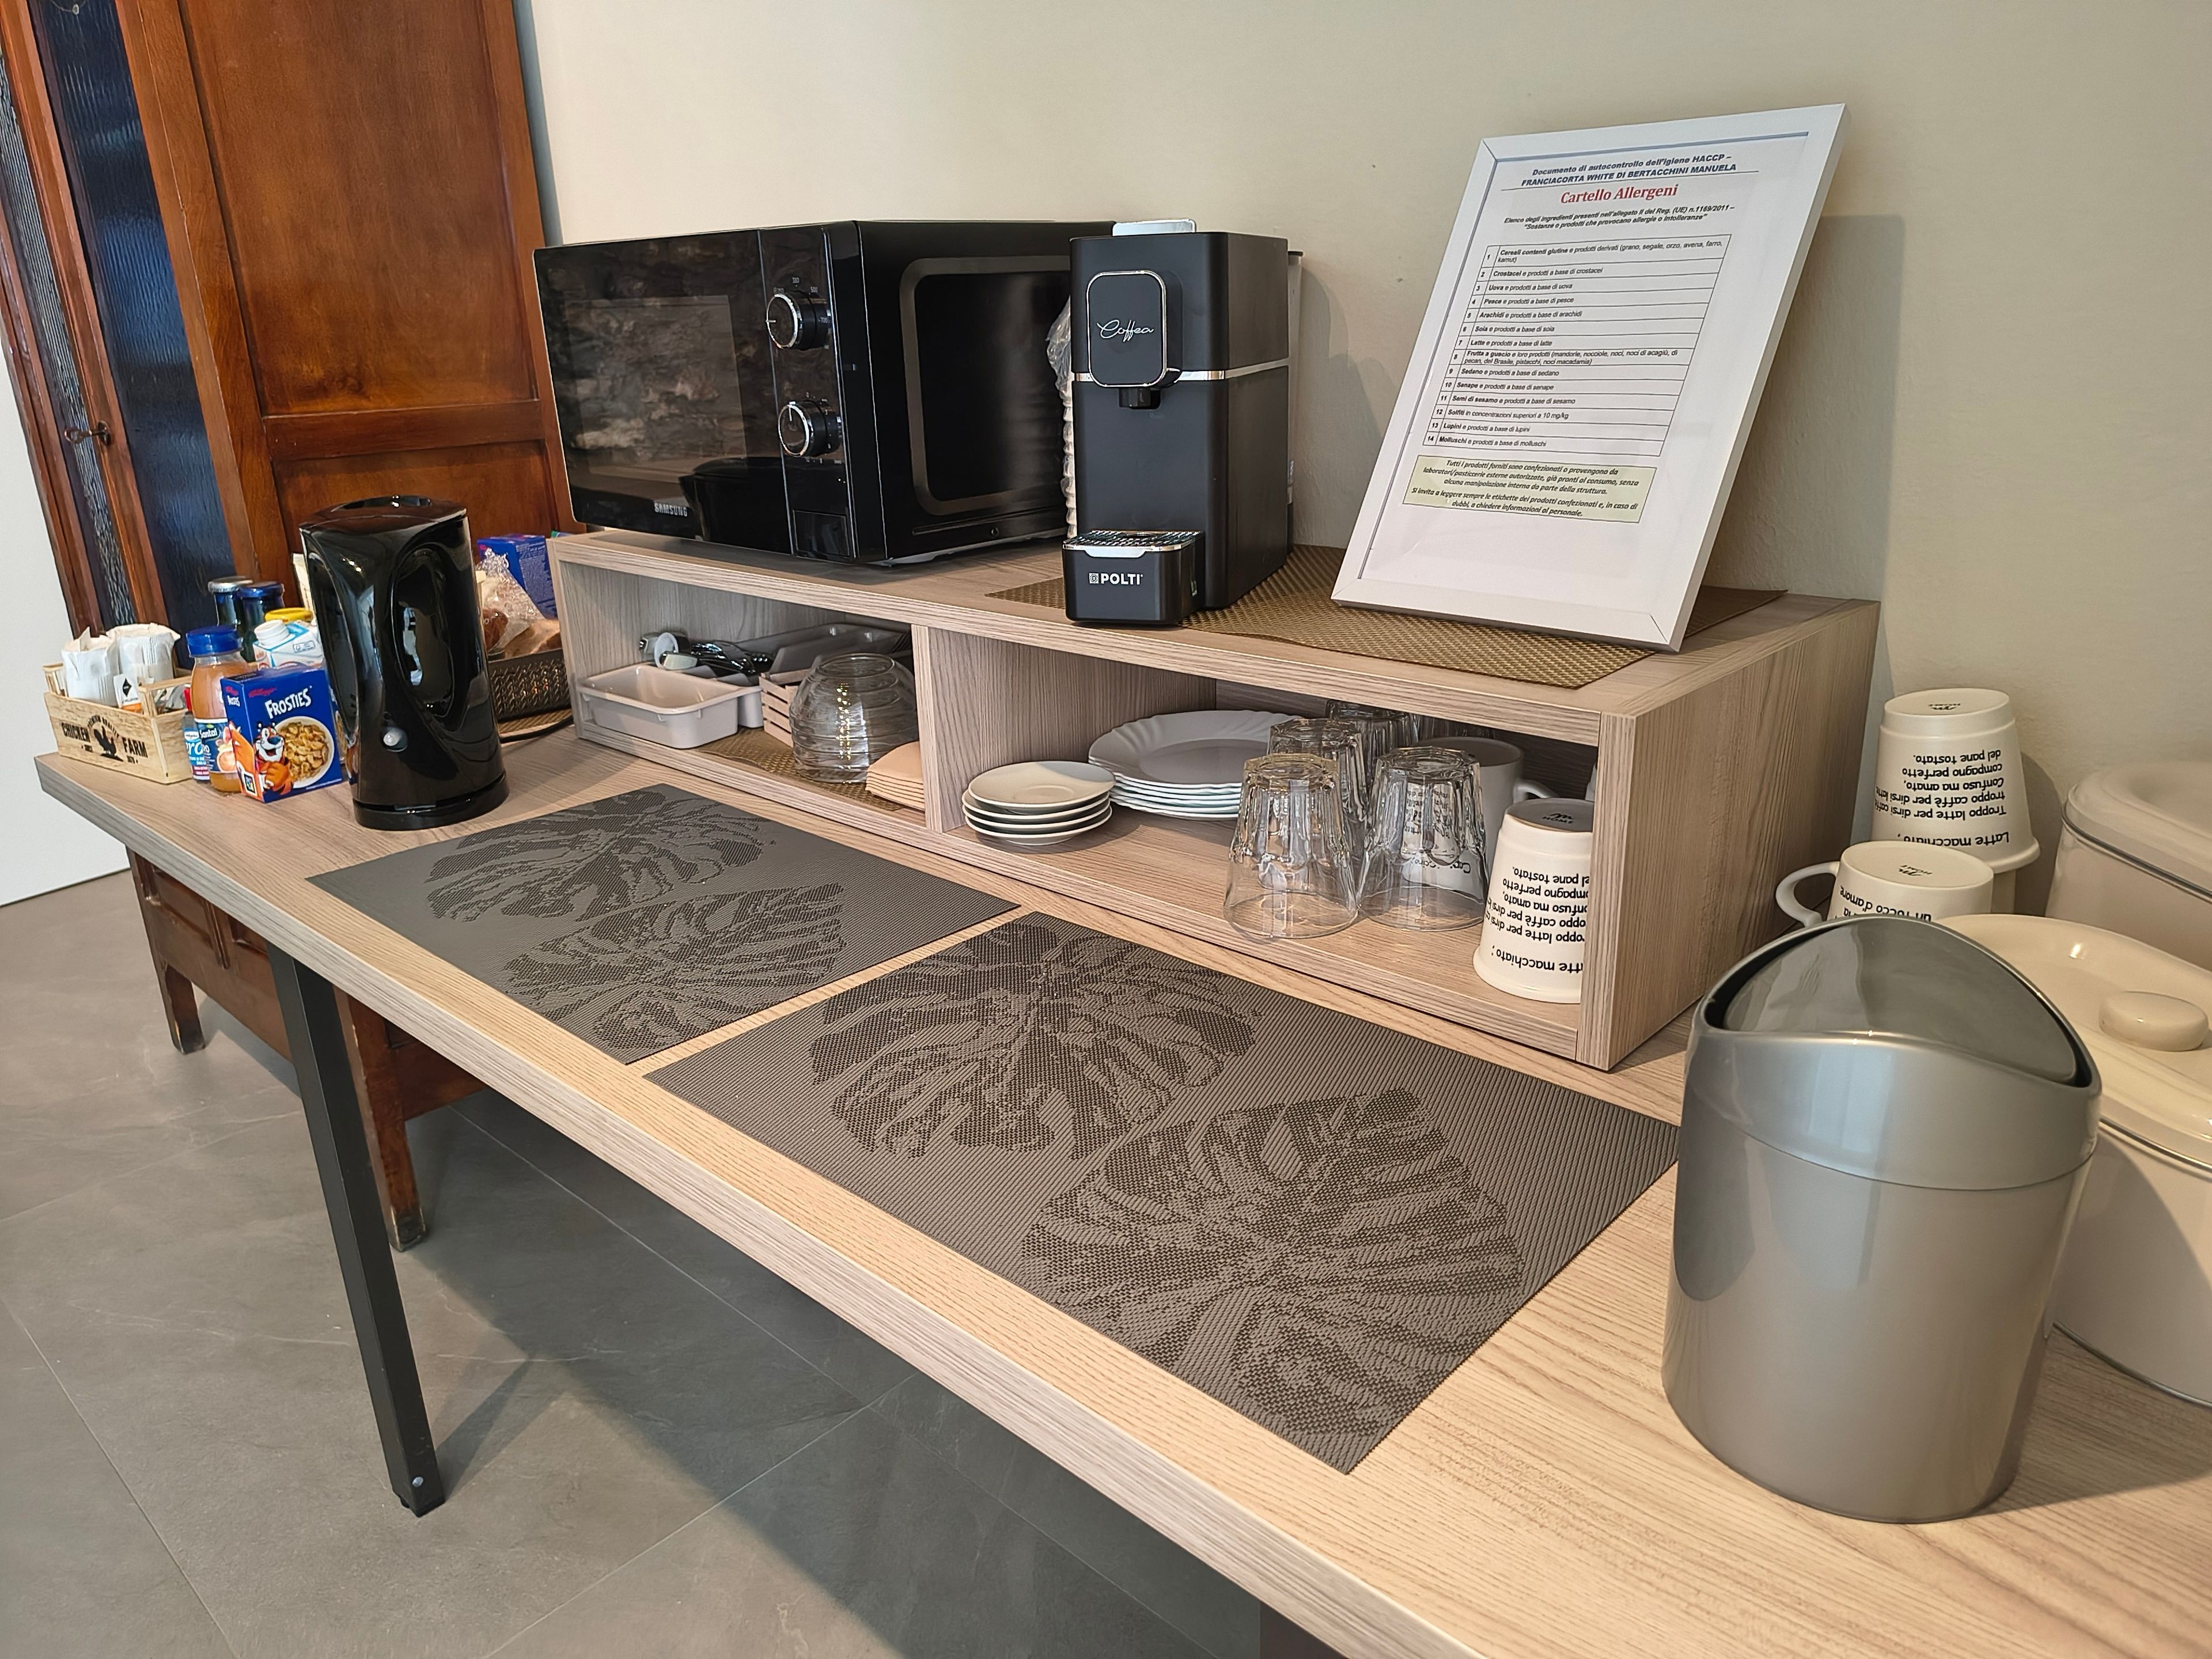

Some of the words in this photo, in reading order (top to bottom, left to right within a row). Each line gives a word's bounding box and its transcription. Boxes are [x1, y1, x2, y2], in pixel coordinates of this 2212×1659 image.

[1532, 166, 1577, 176] Documento
[1587, 160, 1643, 171] autocontrollo
[1645, 157, 1690, 166] dell'igiene
[1691, 153, 1725, 162] HACCP
[1521, 175, 1584, 186] FRANCIACORTA
[1586, 172, 1615, 181] WHITE
[1627, 166, 1689, 177] BERTACCHINI
[1690, 164, 1736, 173] MANUELA
[1560, 188, 1612, 203] Cartello
[1612, 183, 1679, 200] Allergeni
[1097, 319, 1154, 342] Coffea
[654, 502, 687, 517] SAMSUNG
[1101, 573, 1141, 585] POLTI
[264, 688, 312, 719] FROSTIES
[61, 722, 91, 743] CHICKEN
[122, 737, 148, 758] FARM
[1913, 755, 1957, 765] tostato.
[1960, 749, 1985, 762] pane
[1988, 749, 2001, 762] del
[1902, 767, 1949, 779] perfetto
[1952, 763, 2002, 777] compagno
[1903, 780, 1940, 791] amato,
[1942, 783, 1960, 791] ma
[1963, 777, 2004, 791] Confuso
[1890, 793, 1910, 805] dirsi
[1912, 794, 1931, 805] per
[1934, 796, 1968, 808] caffè
[1971, 791, 2005, 803] troppo
[1890, 806, 1911, 819] dirsi
[1914, 808, 1933, 818] per
[1936, 810, 1965, 821] latte
[1969, 805, 2007, 816] Troppo
[1975, 831, 2009, 846] Latte
[1512, 866, 1550, 884] tostato.
[1552, 873, 1580, 884] pane
[1581, 876, 1590, 887] el
[1502, 878, 1541, 896] perfetto
[1502, 891, 1531, 908] amato,
[1491, 902, 1506, 916] dirsi
[1533, 902, 1550, 912] ma
[1506, 910, 1522, 921] per
[1525, 915, 1556, 928] caffè
[1559, 916, 1586, 928] oppo
[1490, 916, 1505, 931] dirsi
[1506, 925, 1522, 935] per
[1525, 929, 1552, 944] latte
[1556, 931, 1585, 942] oppo
[1559, 962, 1584, 974] tte
